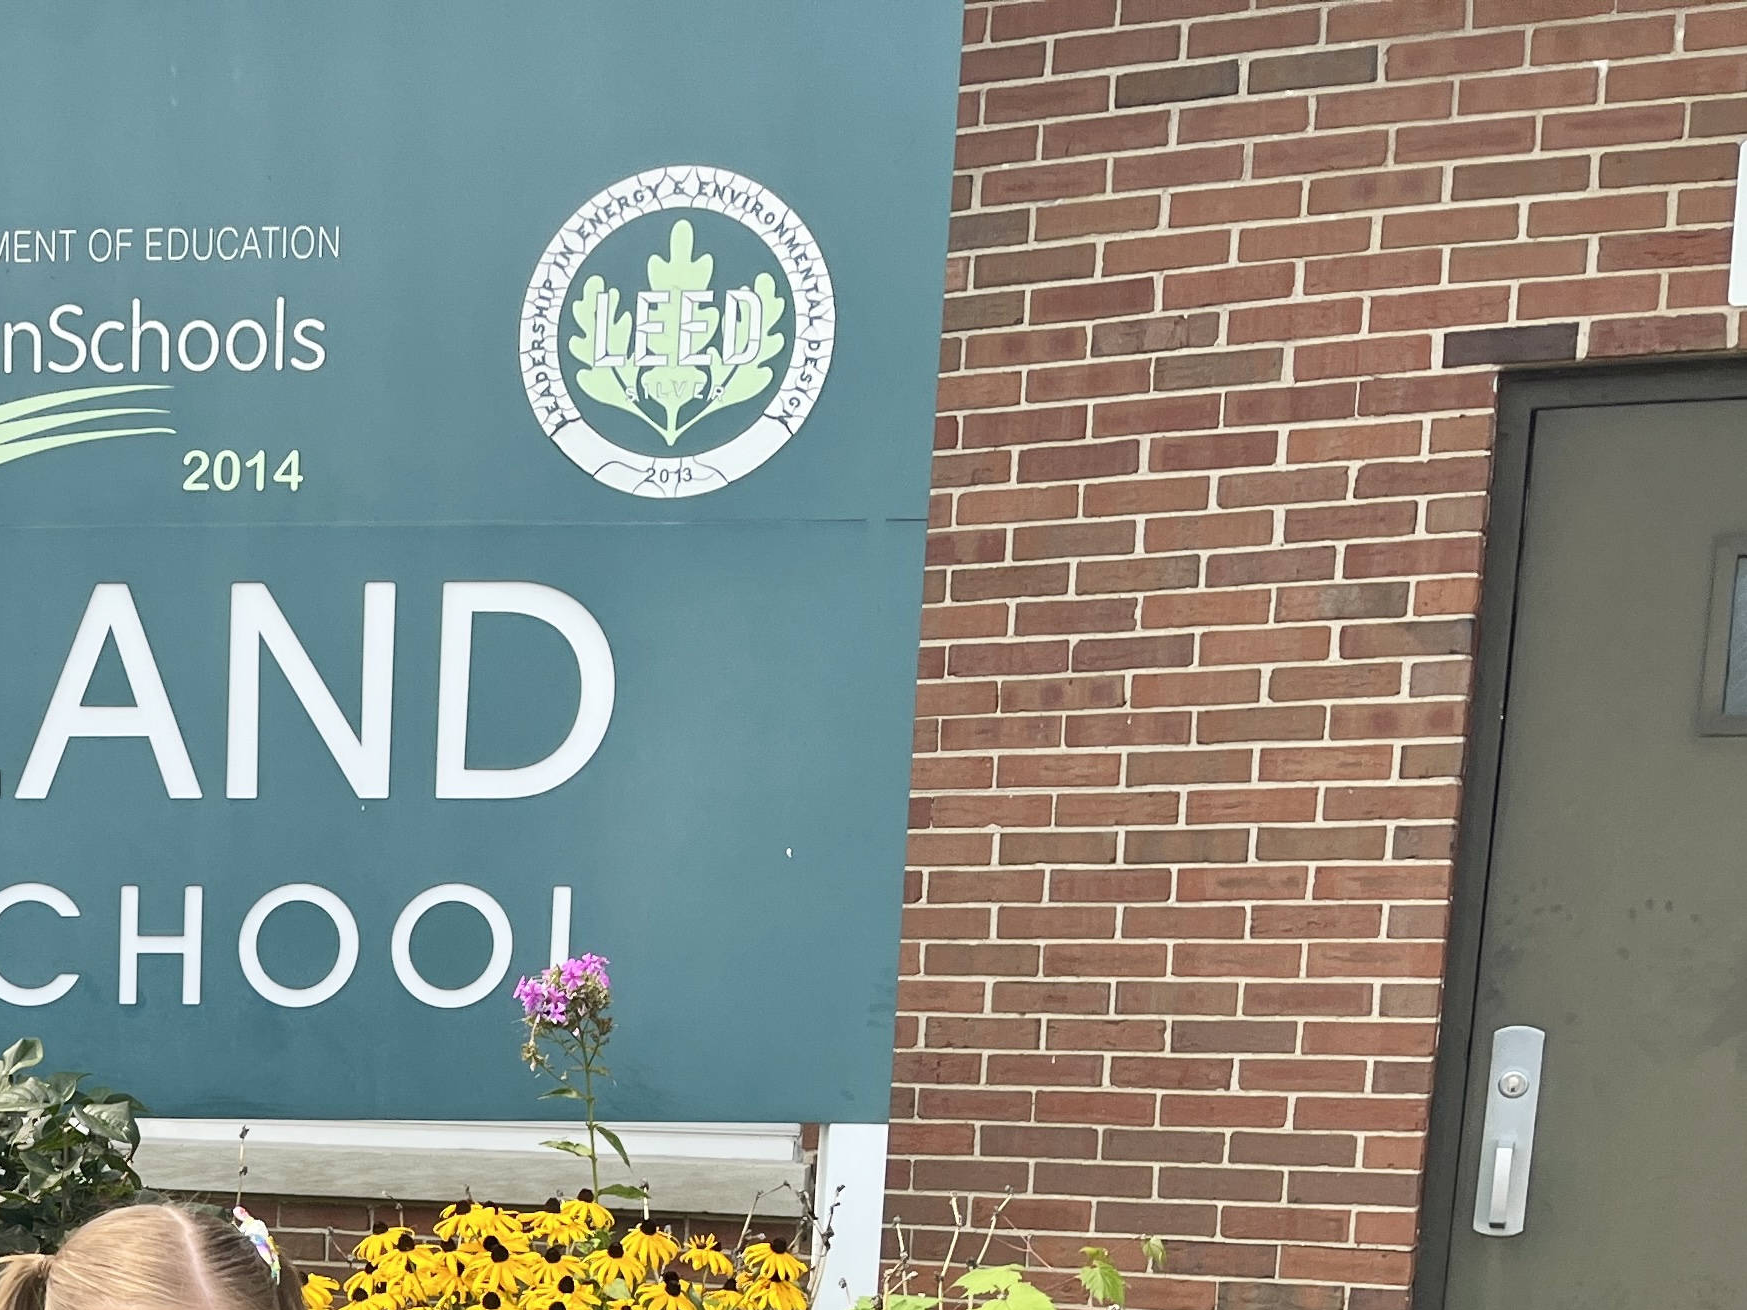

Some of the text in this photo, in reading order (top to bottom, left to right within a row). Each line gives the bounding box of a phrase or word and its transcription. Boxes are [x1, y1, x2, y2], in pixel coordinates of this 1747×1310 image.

[88, 228, 134, 263] OF
[145, 225, 340, 262] EDUCATION
[531, 180, 824, 431] LEADERSHIP IN ENERGY & ENVIRONMENTAL DESIGN
[592, 289, 764, 369] LEED
[625, 381, 725, 403] SILVER
[181, 449, 304, 492] 2014
[643, 467, 693, 484] 2013
